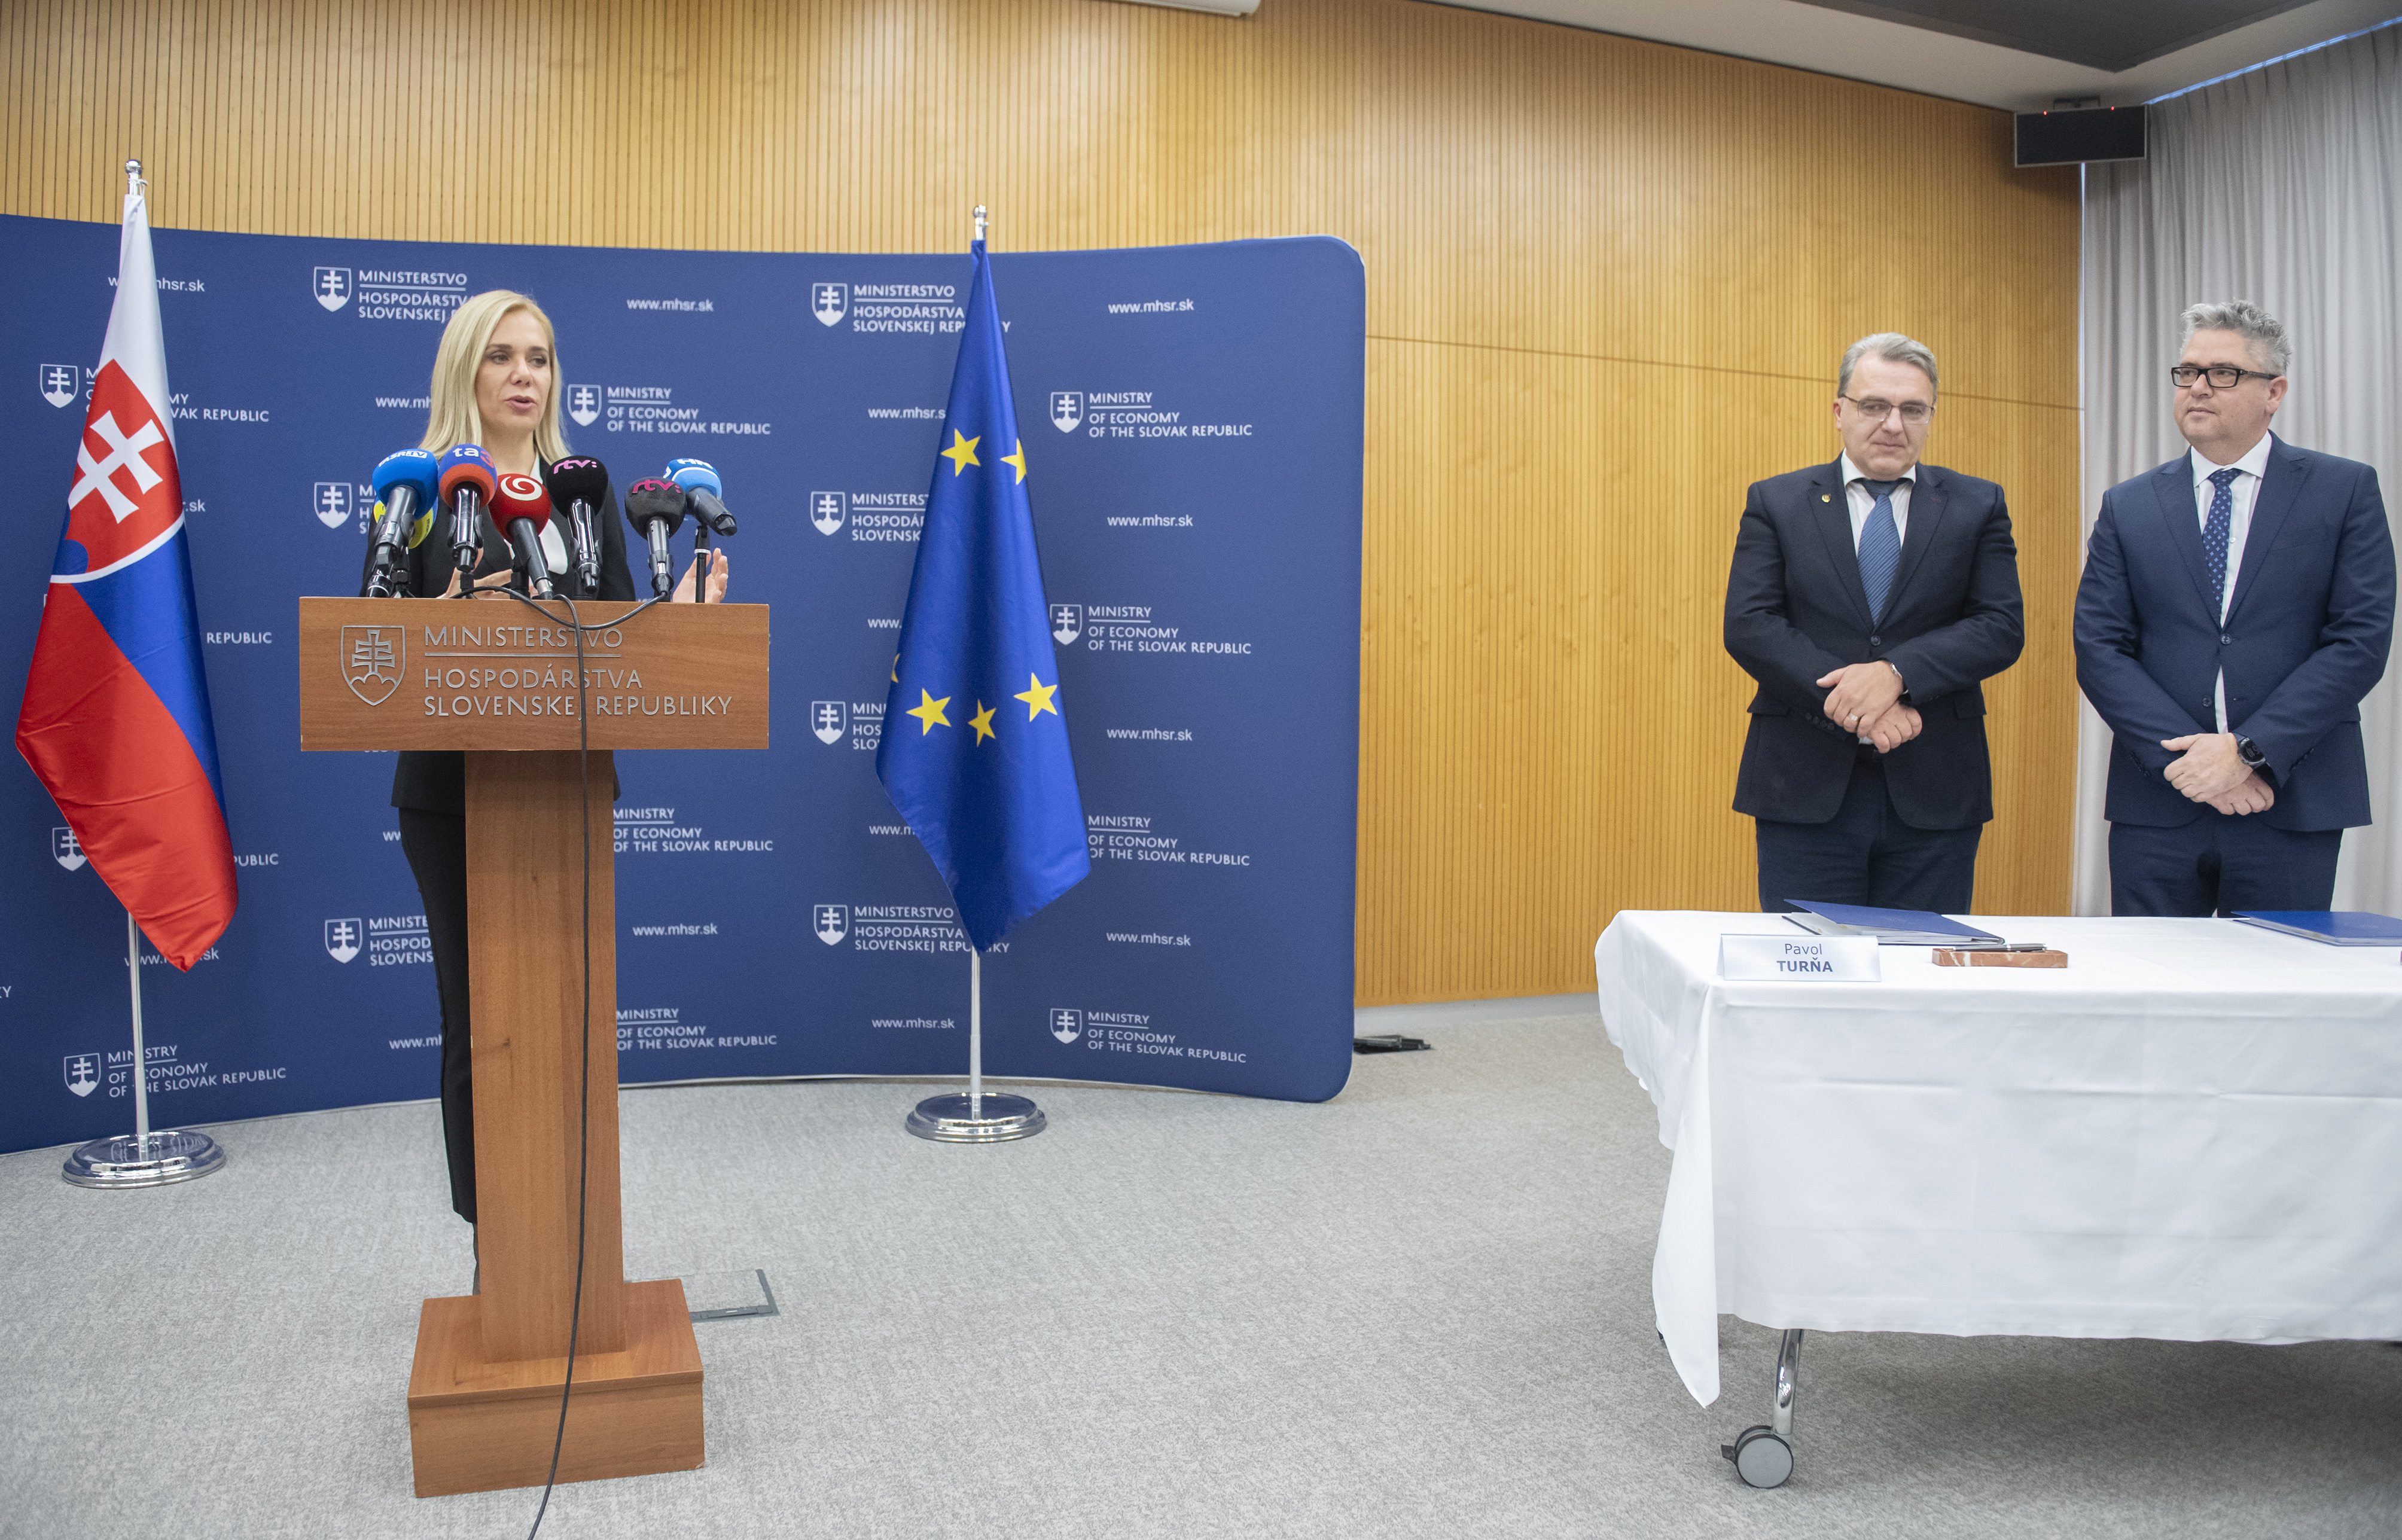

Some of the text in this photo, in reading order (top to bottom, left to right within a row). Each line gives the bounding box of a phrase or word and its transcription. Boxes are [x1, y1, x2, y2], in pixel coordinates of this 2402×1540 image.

[108, 276, 205, 292] whsr.sk
[359, 270, 467, 285] MINISTERSTVO
[854, 285, 955, 297] MINISTERSTVO
[359, 291, 478, 307] HOSPODÁRSTV
[627, 298, 713, 311] www.mhsr.sk
[854, 304, 964, 318] HOSPODÁRSTVA
[1108, 299, 1194, 313] www.mhsr.sk
[359, 306, 445, 323] SLOVENSKEJ
[853, 320, 934, 334] SLOVENSKEJ
[608, 387, 671, 398] MINISTRY
[1090, 392, 1152, 403] MINISTRY
[203, 408, 268, 422] REPUBLIC
[607, 407, 698, 419] OF ECONOMY
[868, 407, 945, 419] www.mhsr.s
[1089, 413, 1179, 424] OF ECONOMY
[607, 420, 770, 434] OF THE SLOVAK REPUBLIC
[1089, 425, 1252, 437] OF THE SLOVAK REPUBLIC
[852, 493, 928, 505] MINISTERS
[1108, 514, 1193, 526] www.mhsr.sk
[1089, 606, 1151, 617] MINISTRY
[207, 632, 271, 644] REPUBLIC
[424, 626, 623, 648] MINISTERSTVO
[1089, 626, 1178, 638] OF ECONOMY
[1089, 640, 1251, 654] OF THE SLOVAK REPUBLIC
[596, 696, 732, 716] REPUBLIKY
[1107, 728, 1192, 740] www.mhsr.sk
[612, 808, 674, 819] MINISTRY
[1089, 816, 1150, 827] MINISTRY
[614, 828, 702, 839] OF ECONOMY
[614, 841, 772, 852] OF THE SLOVAK REPUBLIC
[1089, 835, 1178, 848] OF ECONOMY
[234, 853, 279, 867] UBLIC
[1109, 849, 1132, 859] THE
[1138, 850, 1185, 862] SLOVAK
[1191, 853, 1249, 865] REPUBLIC
[855, 907, 953, 918] MINISTERSTVO
[633, 923, 717, 935] www.mhsr.sk
[855, 925, 963, 938] HOSPODÁRSTVA
[1106, 933, 1190, 946] www.mhsr.sk
[855, 940, 934, 953] SLOVENSKEJ
[1785, 944, 1822, 955] Pavol
[1777, 957, 1833, 972] TURŇA
[616, 1008, 679, 1021] MINISTRY
[1089, 1012, 1149, 1024] MINISTRY
[872, 1018, 955, 1028] www.mhsr.sk
[617, 1026, 706, 1039] OF ECONOMY
[1088, 1029, 1176, 1045] OF ECONOMY
[617, 1035, 776, 1051] OF THE SLOVAK REPUBLIC
[108, 1045, 178, 1063] MINSTRY
[1088, 1041, 1246, 1063] OF THE SLOVAK REPUBLIC
[109, 1062, 208, 1084] OF ONOMY
[109, 1085, 127, 1097] OF
[164, 1075, 217, 1091] SLOVAK
[222, 1068, 285, 1084] REPUBLIC
